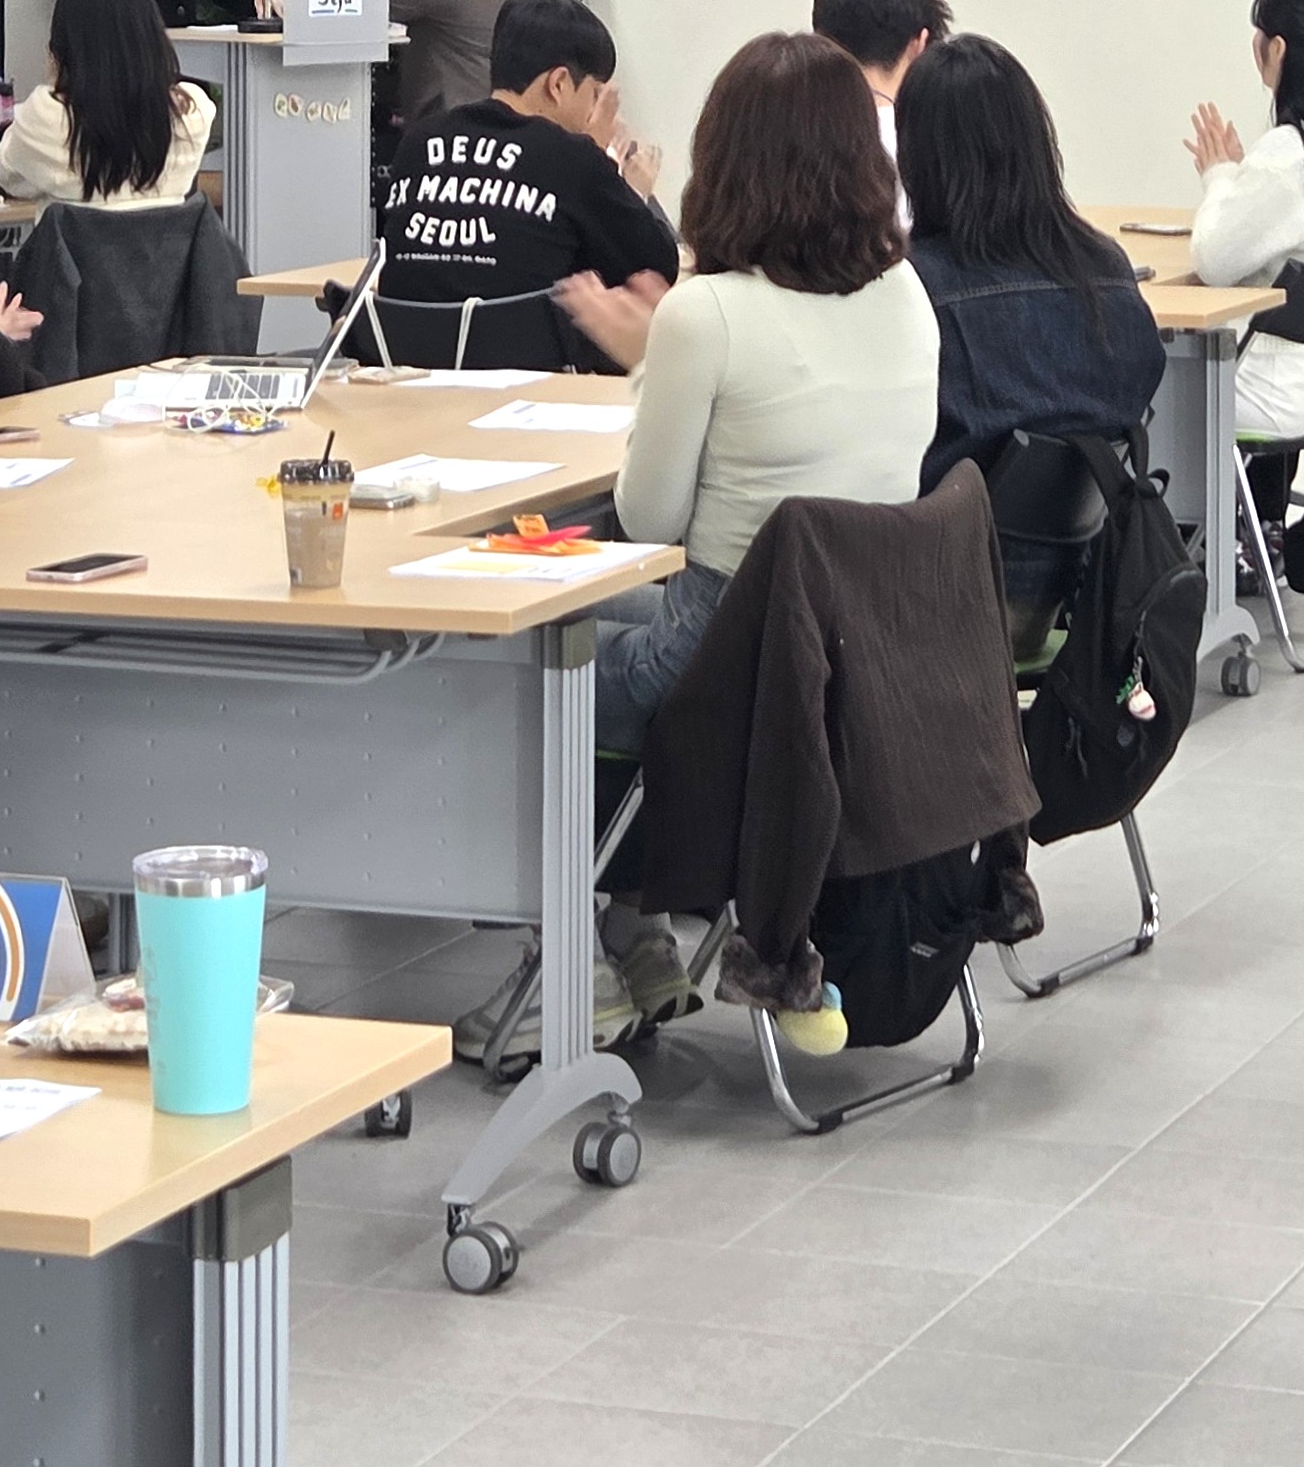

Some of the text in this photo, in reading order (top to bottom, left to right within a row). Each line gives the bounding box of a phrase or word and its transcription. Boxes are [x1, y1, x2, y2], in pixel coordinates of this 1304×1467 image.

[427, 135, 523, 170] DEUS
[417, 174, 557, 223] MACHINA
[405, 212, 496, 247] SEOUL
